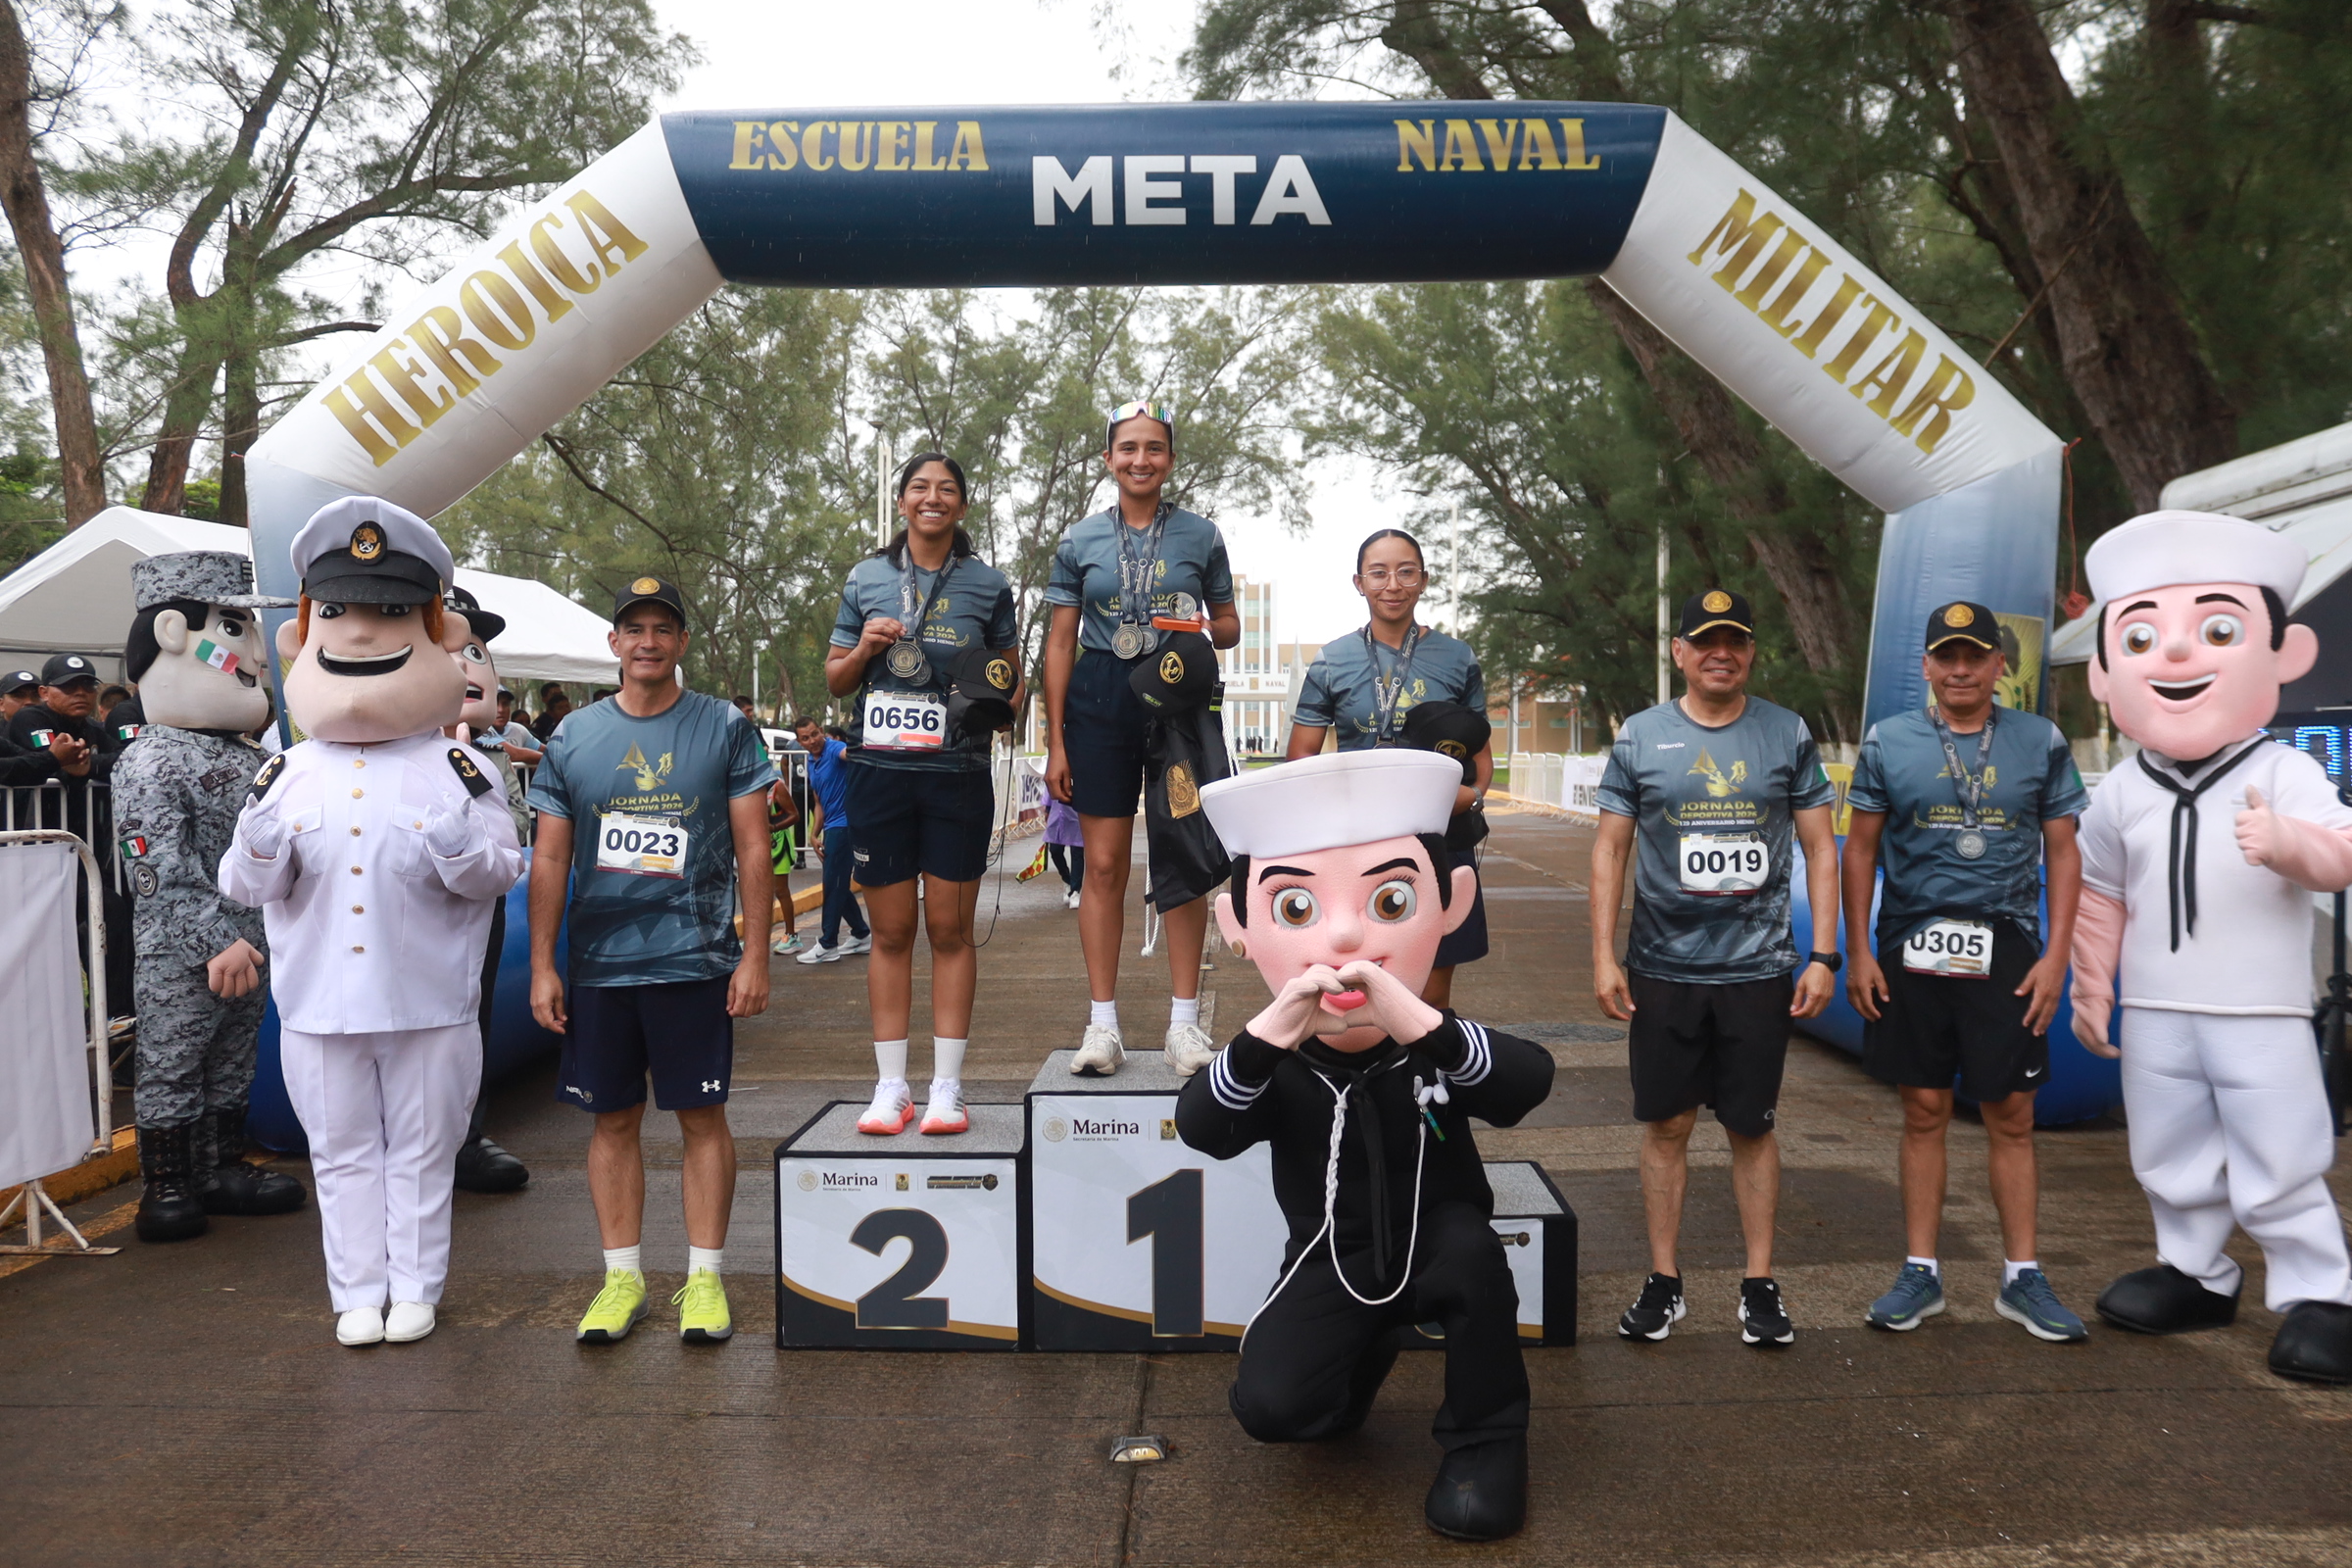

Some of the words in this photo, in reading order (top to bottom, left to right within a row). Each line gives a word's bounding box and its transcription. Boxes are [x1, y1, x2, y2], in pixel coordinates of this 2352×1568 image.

[728, 121, 990, 172] ESCUELA
[1393, 118, 1601, 172] NAVAL
[1032, 154, 1333, 226] META
[320, 188, 649, 467] HEROICA
[1687, 186, 1977, 455] MILITAR
[1108, 594, 1174, 605] JOADA
[869, 706, 940, 732] 0656
[1656, 742, 1686, 751] Tiburcio
[609, 792, 682, 807] JORNADA
[662, 802, 684, 810] 2026
[1680, 801, 1756, 811] JORNADA
[606, 828, 680, 858] 0023
[1687, 849, 1763, 874] 0019
[1910, 930, 1984, 957] 0305
[1072, 1118, 1140, 1135] Marina
[822, 1172, 878, 1186] Marina
[1126, 1167, 1205, 1338] 1
[849, 1206, 950, 1330] 2
